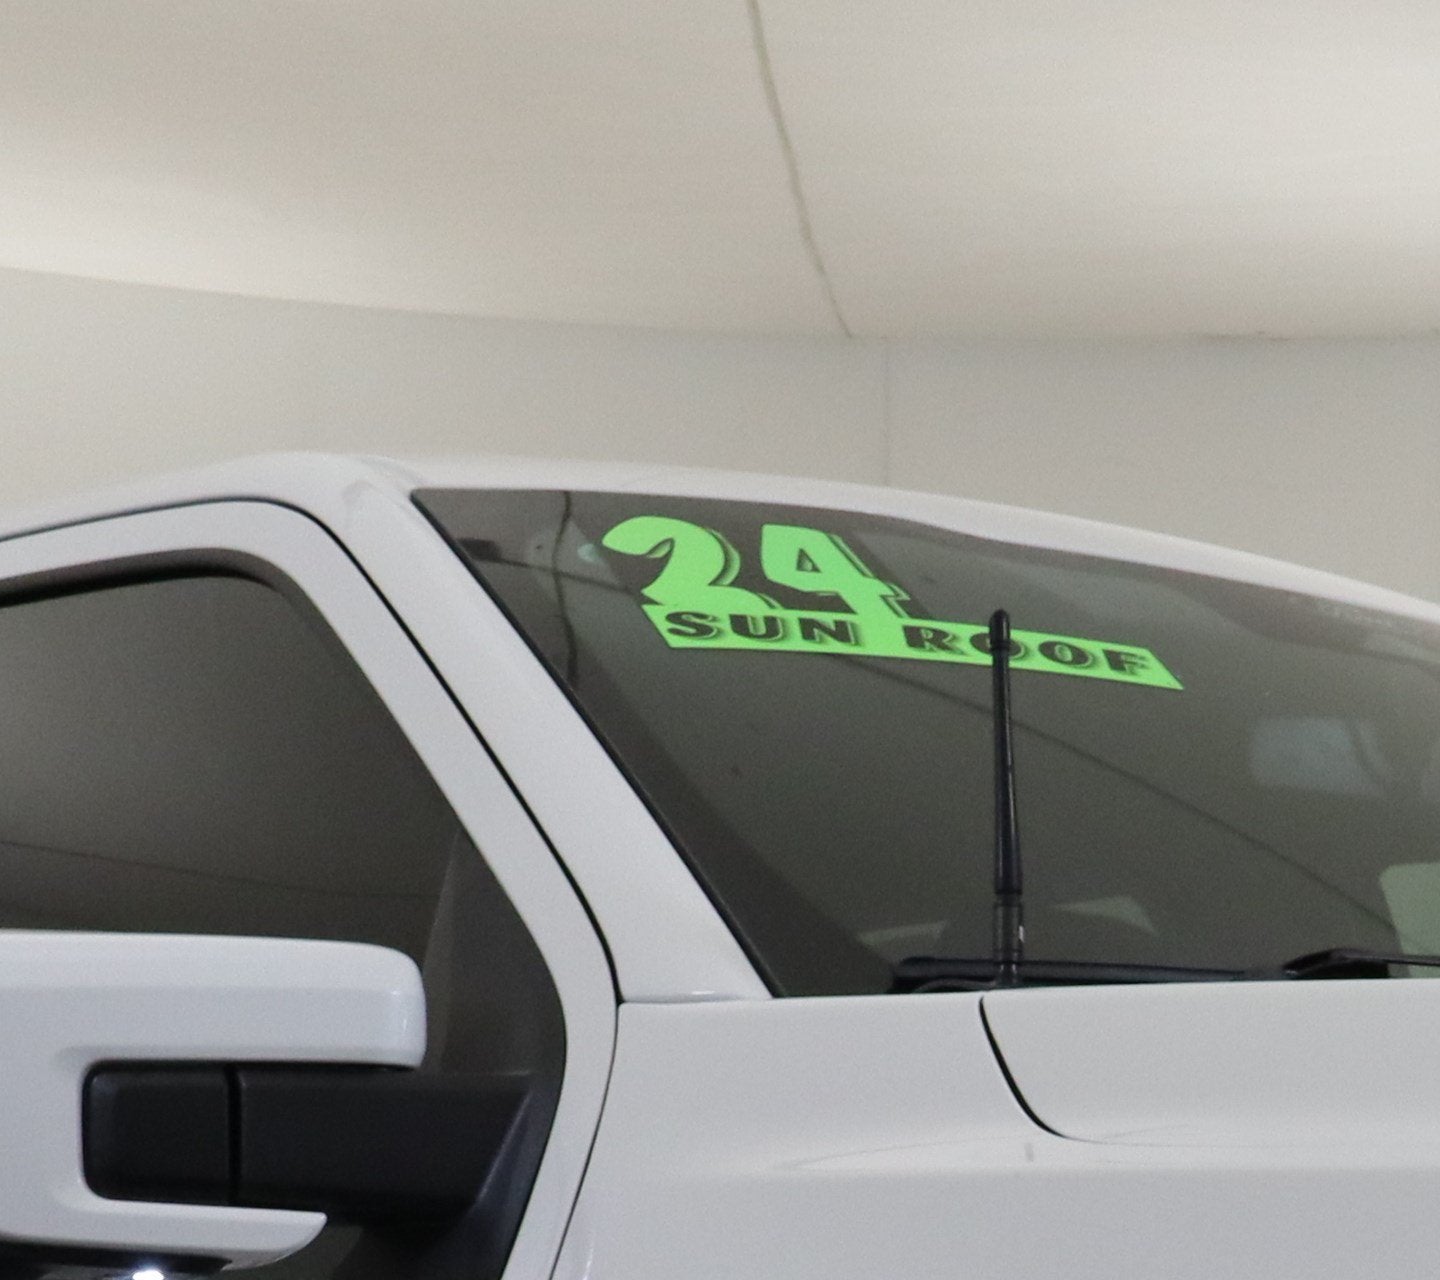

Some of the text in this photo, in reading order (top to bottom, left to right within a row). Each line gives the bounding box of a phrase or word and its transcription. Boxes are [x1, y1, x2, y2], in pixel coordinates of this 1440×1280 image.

[602, 515, 910, 614] 24
[665, 611, 1153, 677] SUN ROOF
